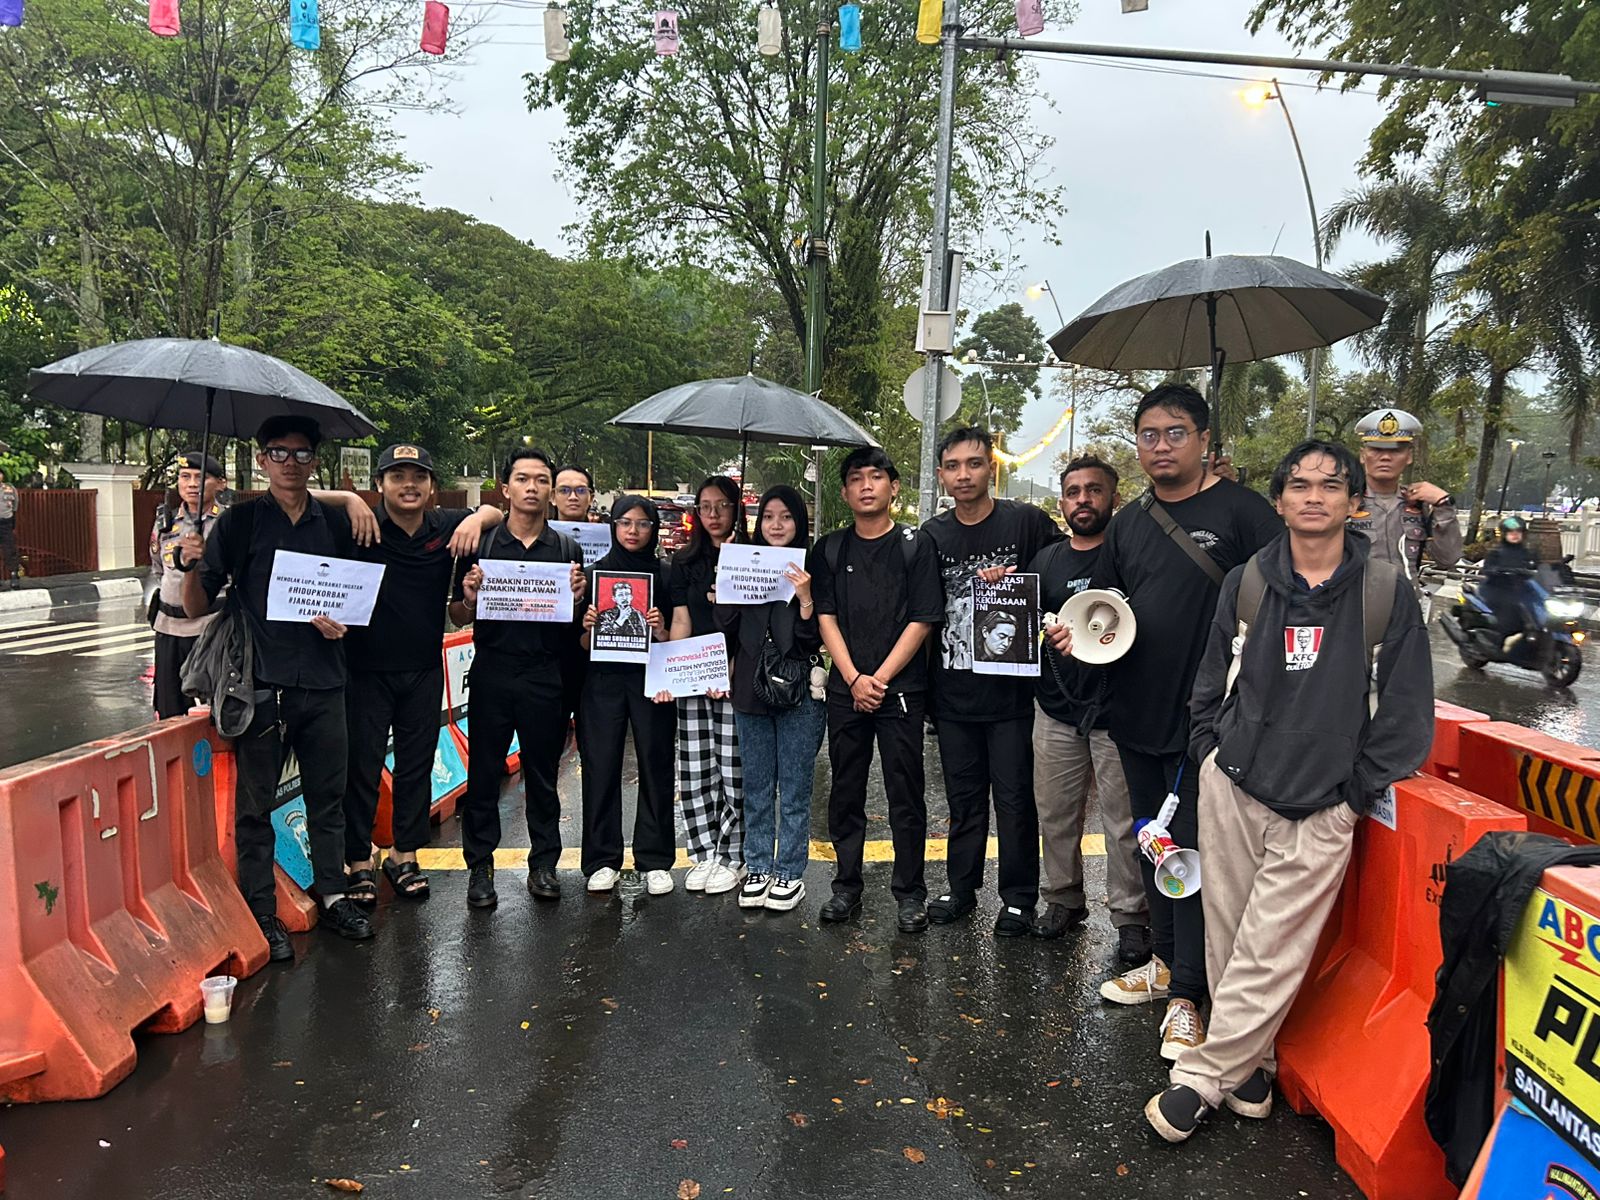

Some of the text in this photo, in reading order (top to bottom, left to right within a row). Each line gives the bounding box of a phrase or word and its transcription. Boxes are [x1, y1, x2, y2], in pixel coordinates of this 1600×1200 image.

[731, 574, 778, 583] #HIDUPKORBAN!
[288, 586, 348, 599] #HIDUPKORBAN!
[975, 584, 1014, 592] SEKARAT,
[288, 598, 344, 609] #JANGAN DIAM!
[975, 597, 1026, 606] KEKUASAAN
[298, 608, 330, 618] #LAWAN!
[693, 659, 726, 668] PERADILAN
[698, 672, 727, 681] MENOLAK
[1514, 1066, 1600, 1158] SATLANTAS
